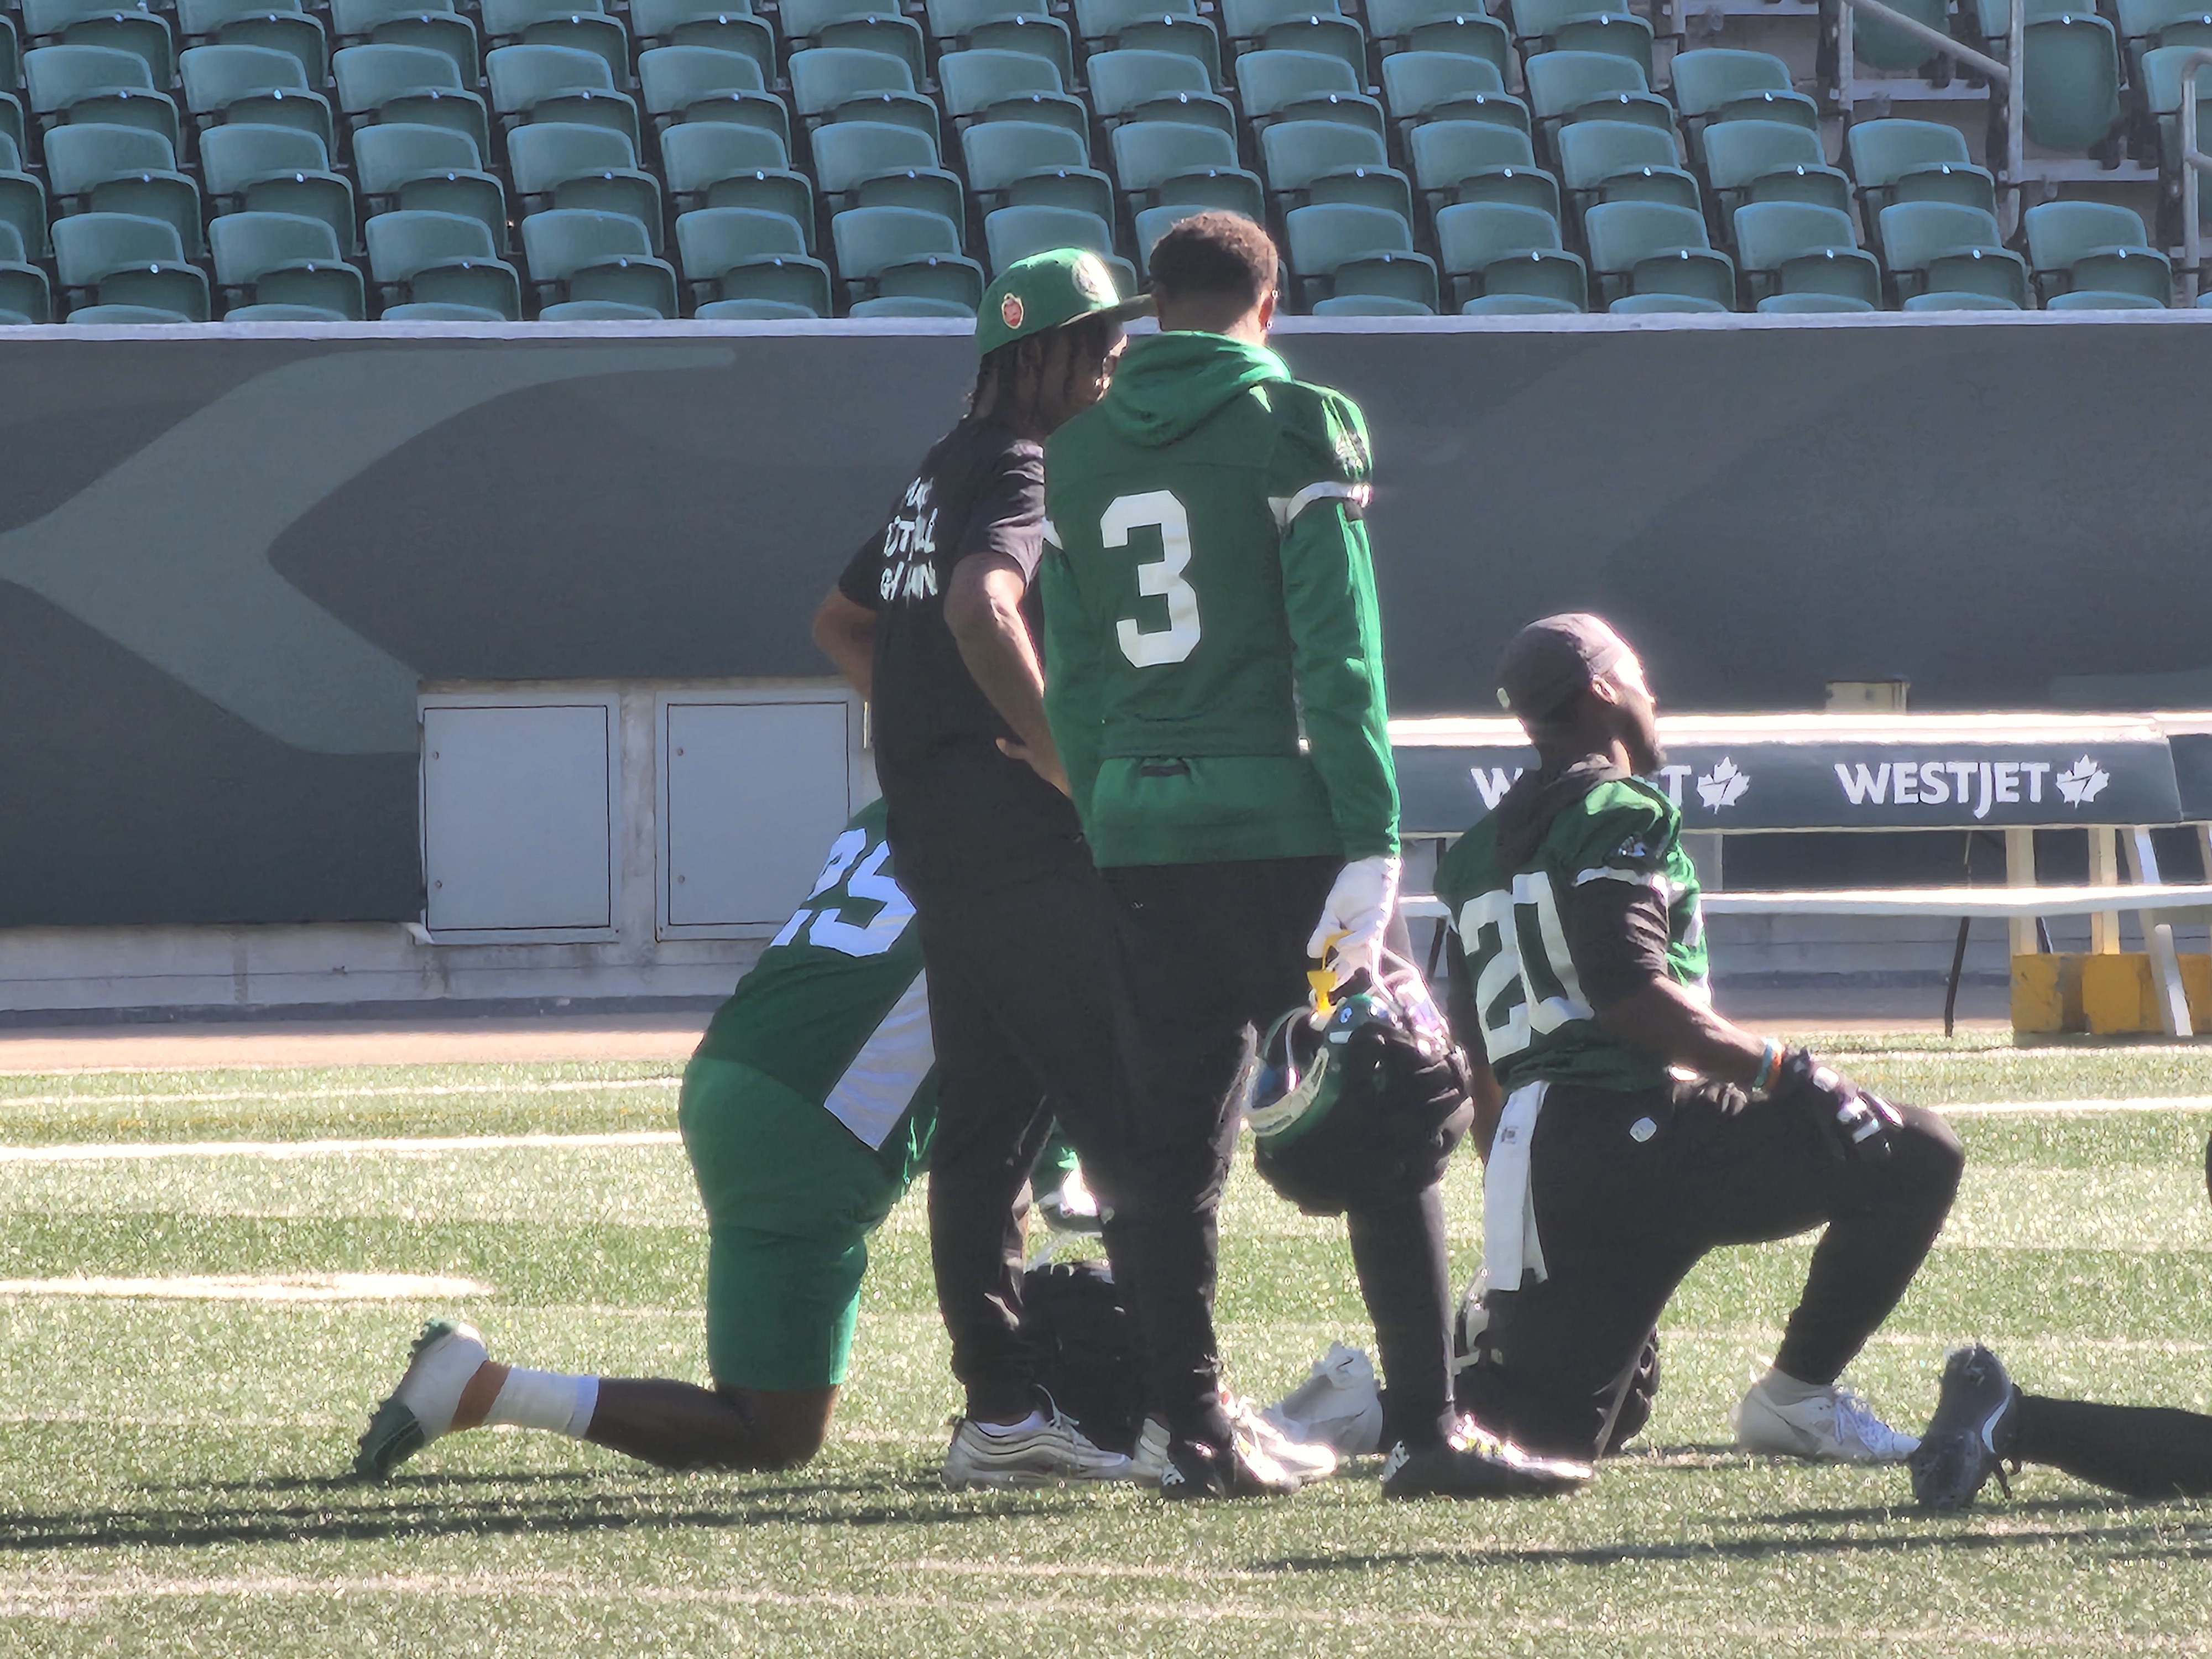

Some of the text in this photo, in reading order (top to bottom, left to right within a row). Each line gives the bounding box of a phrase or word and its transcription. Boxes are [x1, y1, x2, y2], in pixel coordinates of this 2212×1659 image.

[1100, 489, 1201, 669] 3
[1834, 761, 2049, 820] WESTJET
[1458, 870, 1595, 1064] 20
